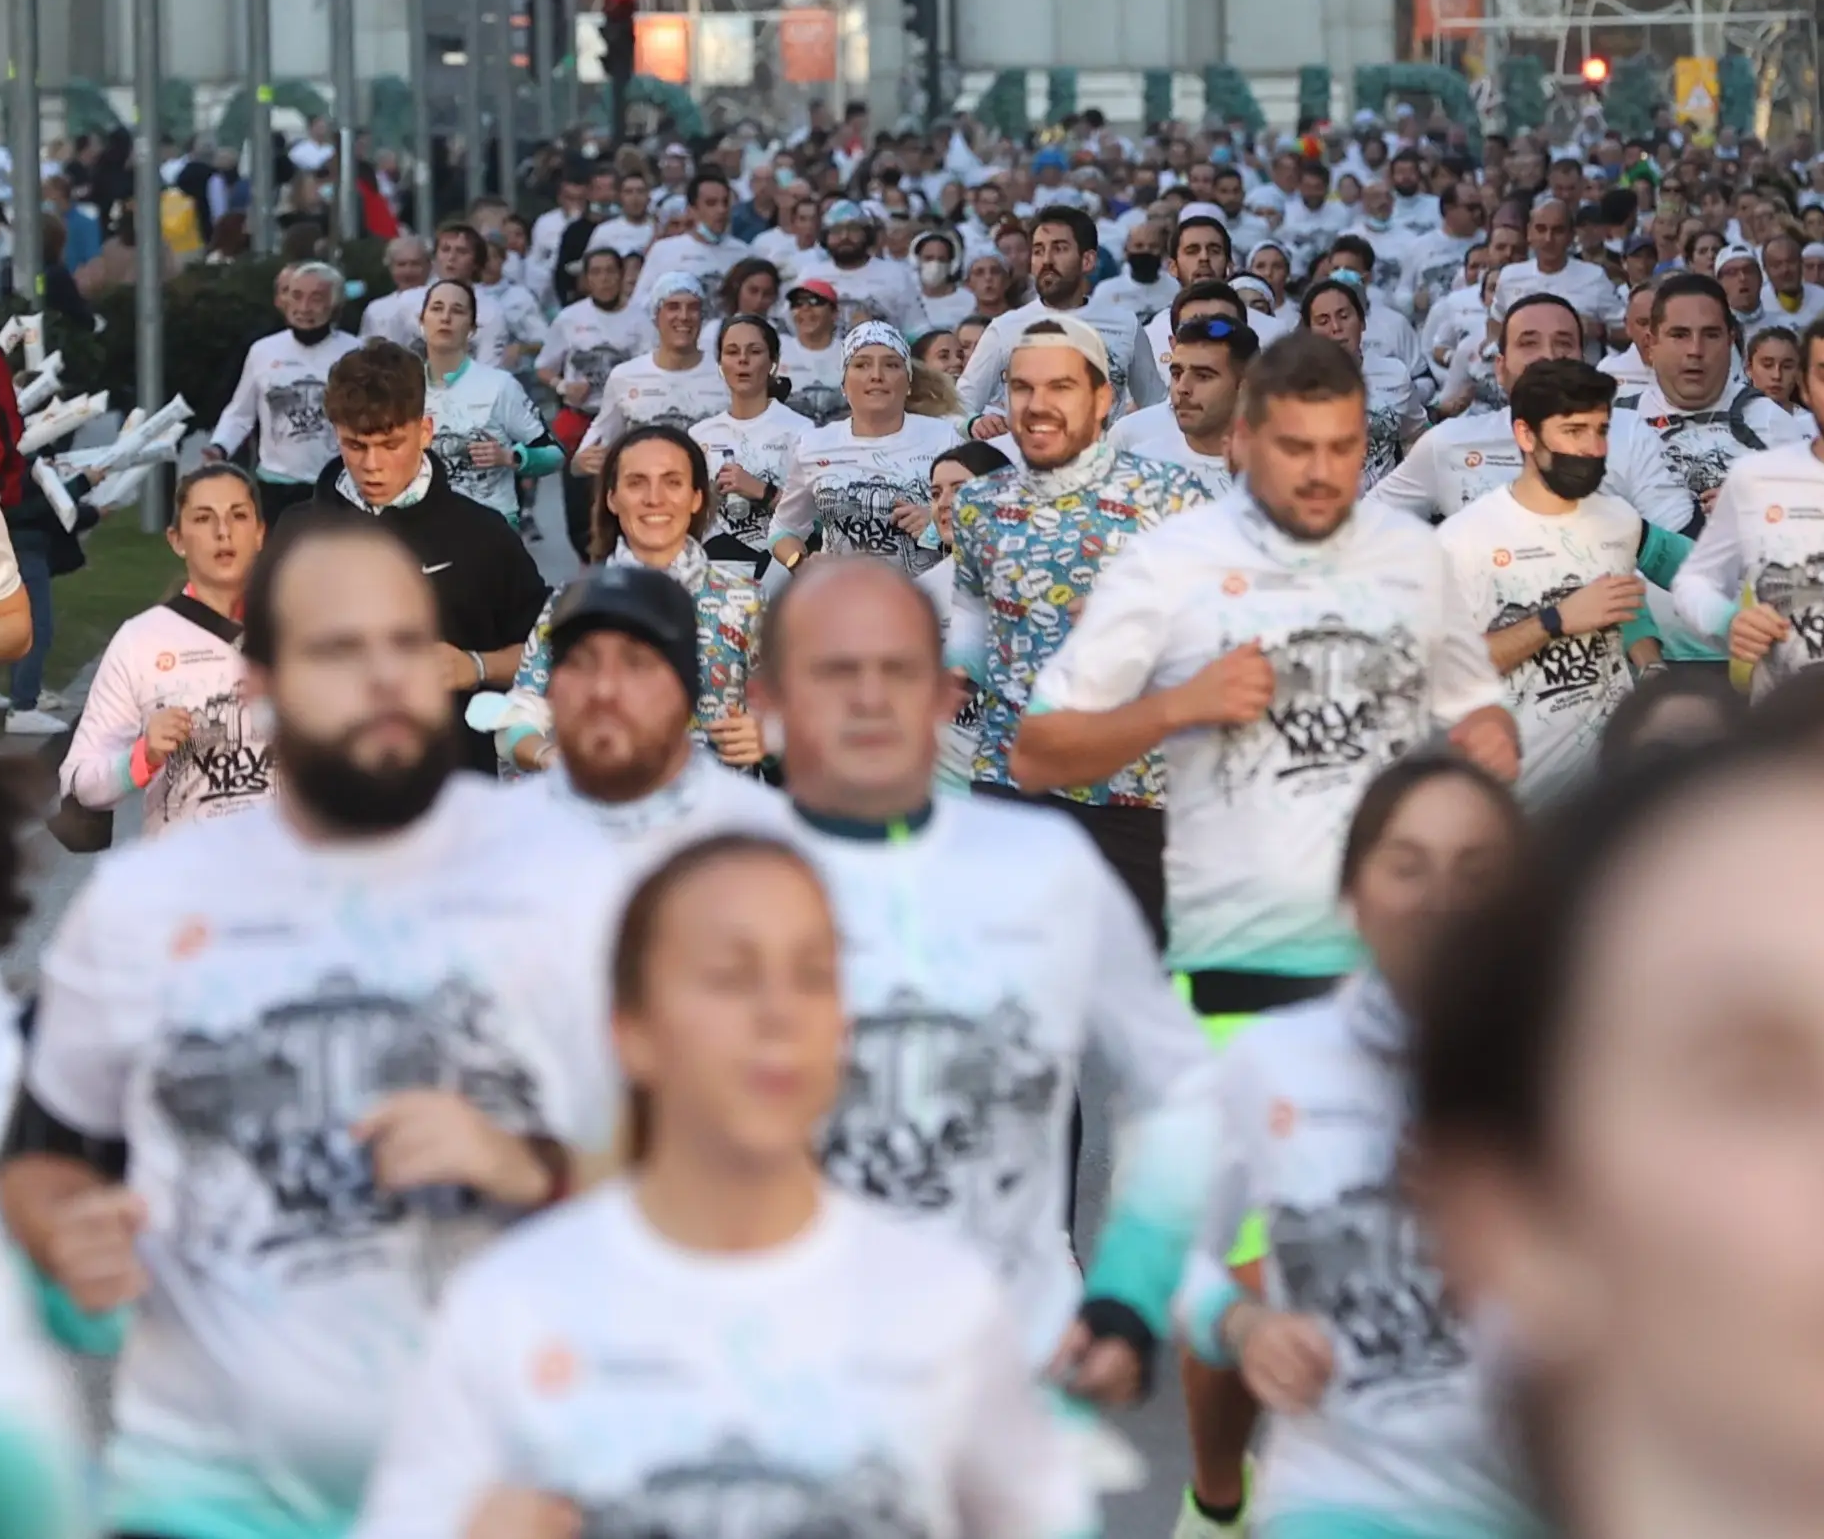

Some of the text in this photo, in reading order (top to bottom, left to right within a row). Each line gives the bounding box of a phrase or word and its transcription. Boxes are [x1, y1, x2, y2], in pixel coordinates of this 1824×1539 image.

[1531, 634, 1608, 667] VOLVE
[1542, 661, 1600, 686] MOS
[192, 744, 269, 774] VOLV
[207, 770, 269, 792] MOS
